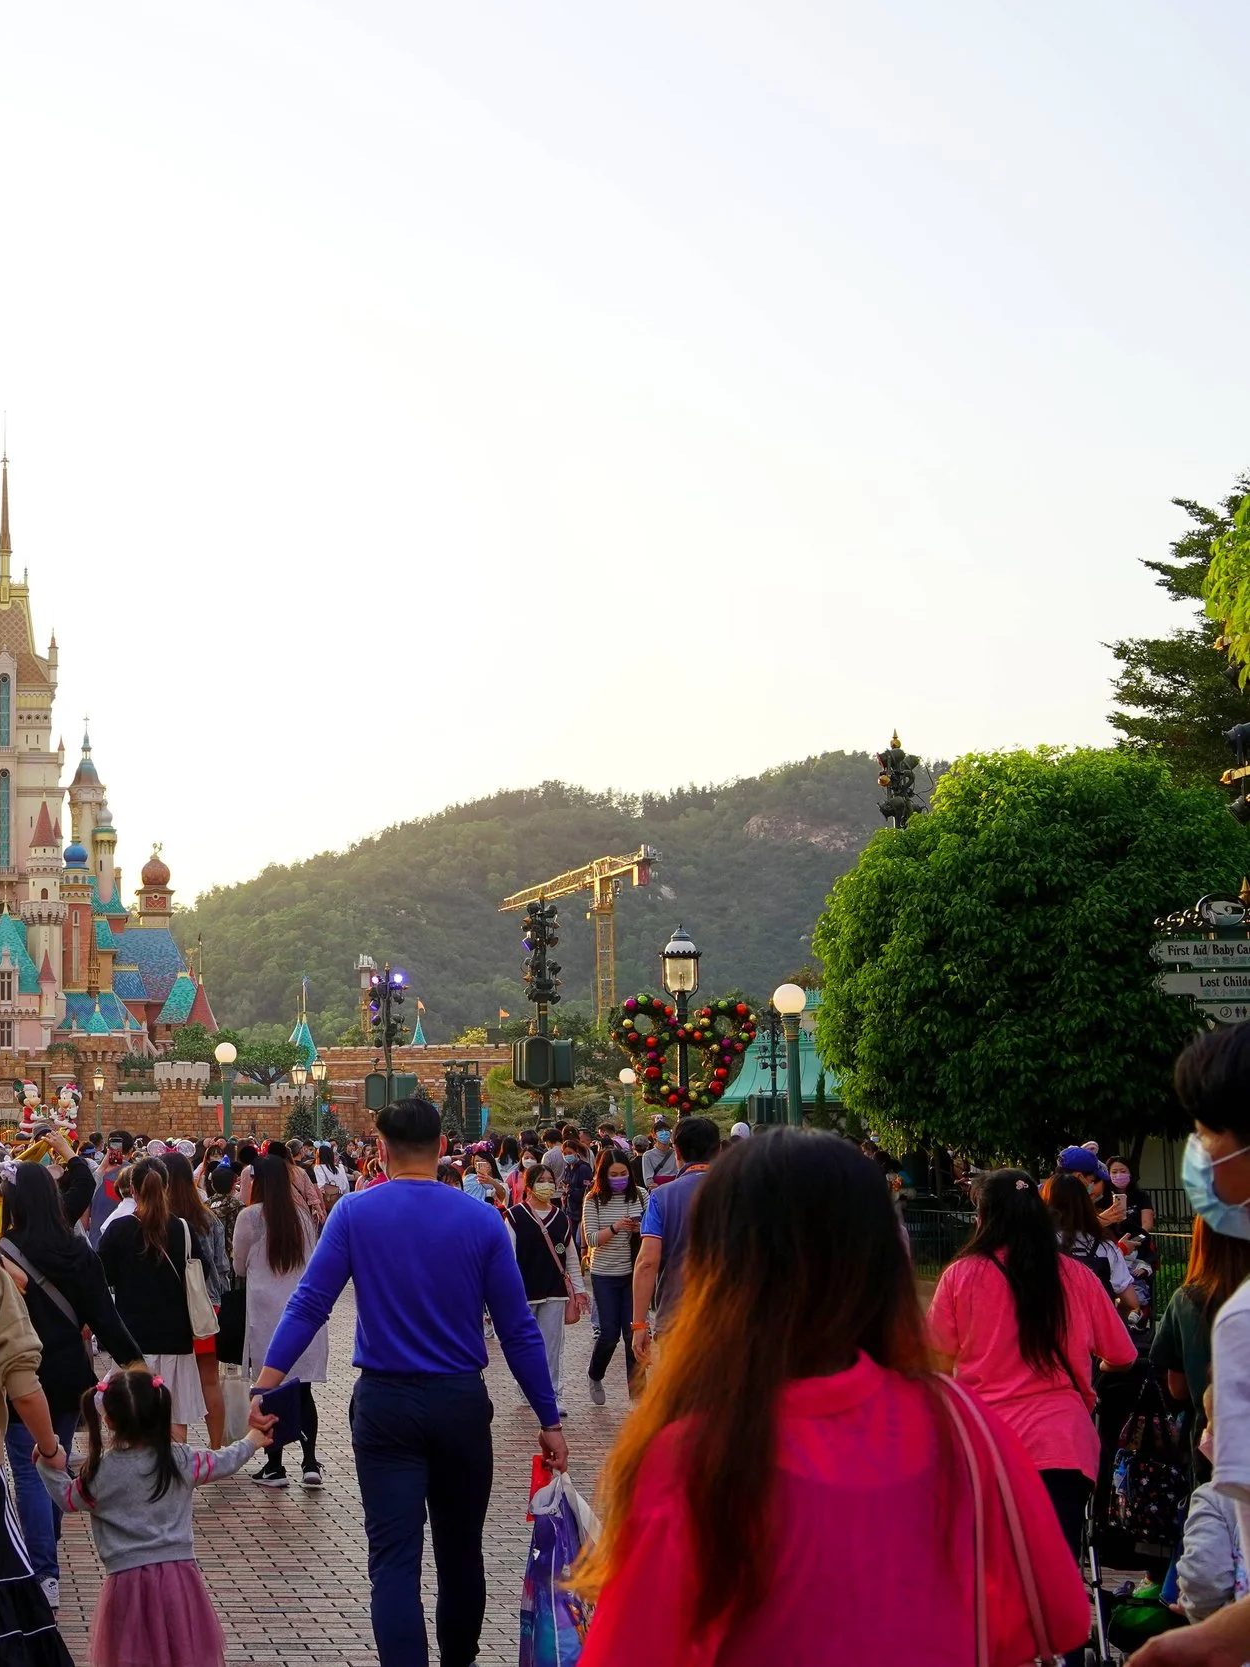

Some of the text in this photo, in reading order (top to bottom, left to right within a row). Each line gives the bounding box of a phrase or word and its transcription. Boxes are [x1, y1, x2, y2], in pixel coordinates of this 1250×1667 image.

[1167, 944, 1189, 955] First
[1236, 944, 1250, 954] Ca
[1200, 976, 1250, 987] Lost Child
